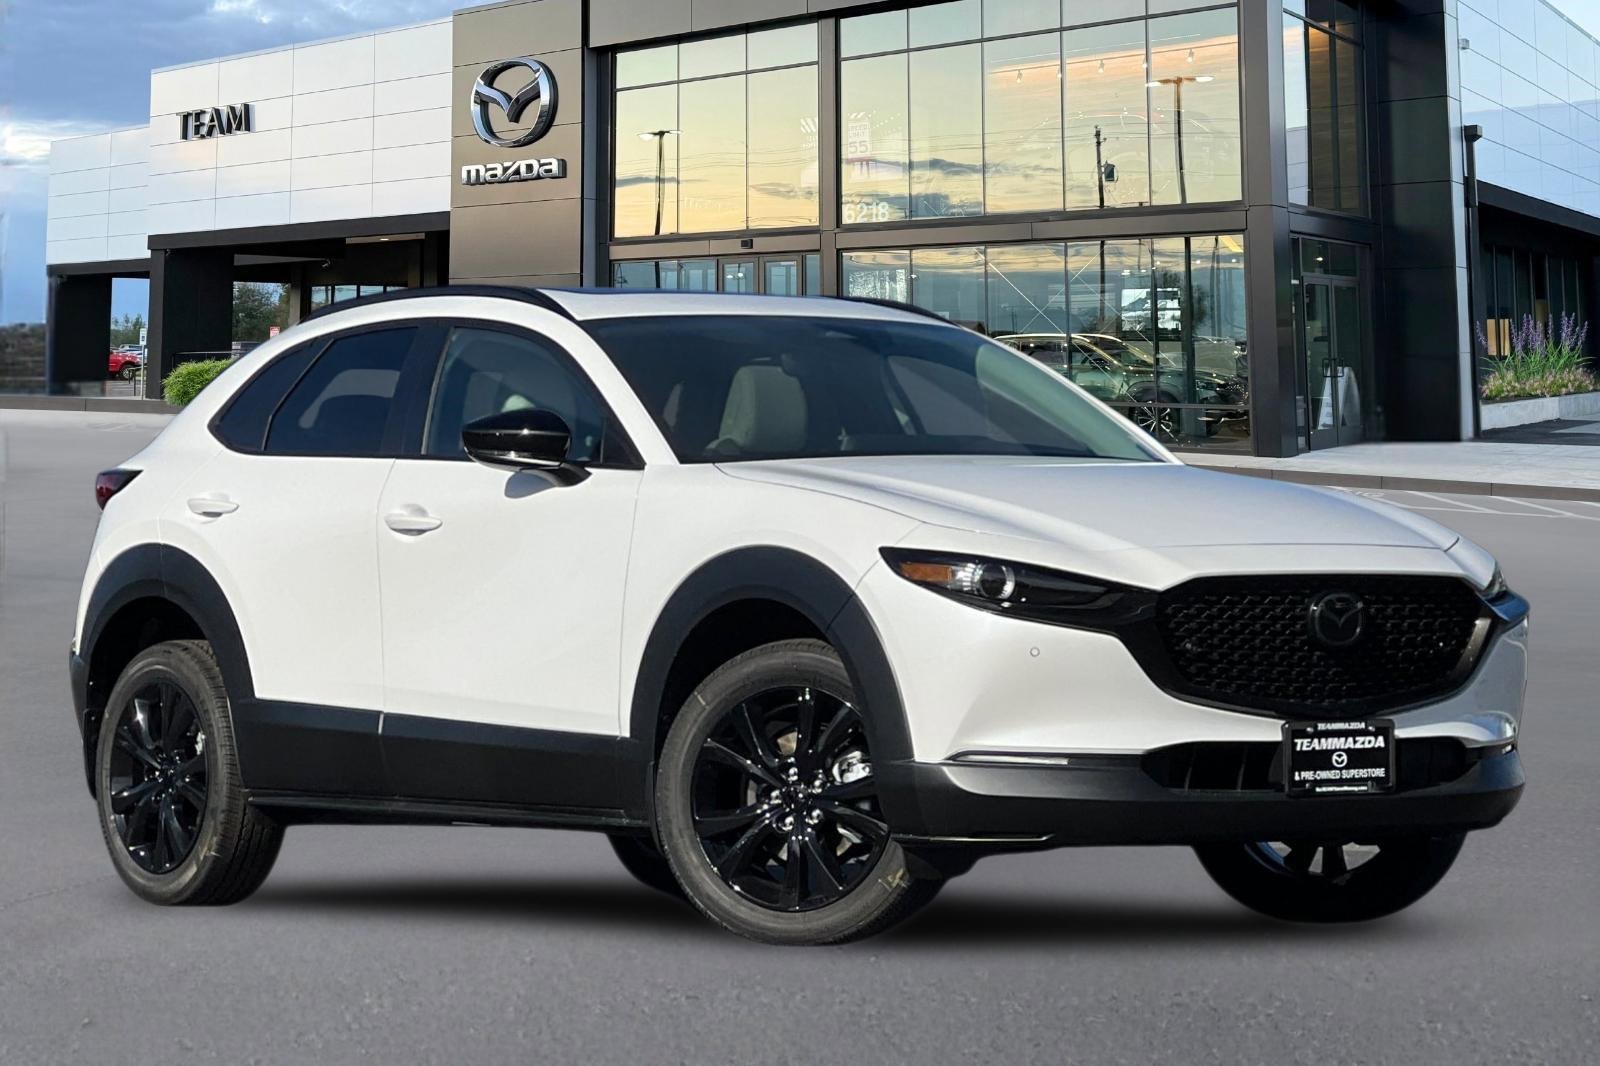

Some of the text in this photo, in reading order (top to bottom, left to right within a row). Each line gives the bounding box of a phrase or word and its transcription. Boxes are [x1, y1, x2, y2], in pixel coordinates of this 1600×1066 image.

[176, 103, 251, 140] TEAM
[843, 201, 889, 223] 6218
[1294, 736, 1385, 751] TEAMMAZDA
[1300, 770, 1340, 780] PRE-OWNED
[1341, 768, 1386, 779] SUPERSTORE
